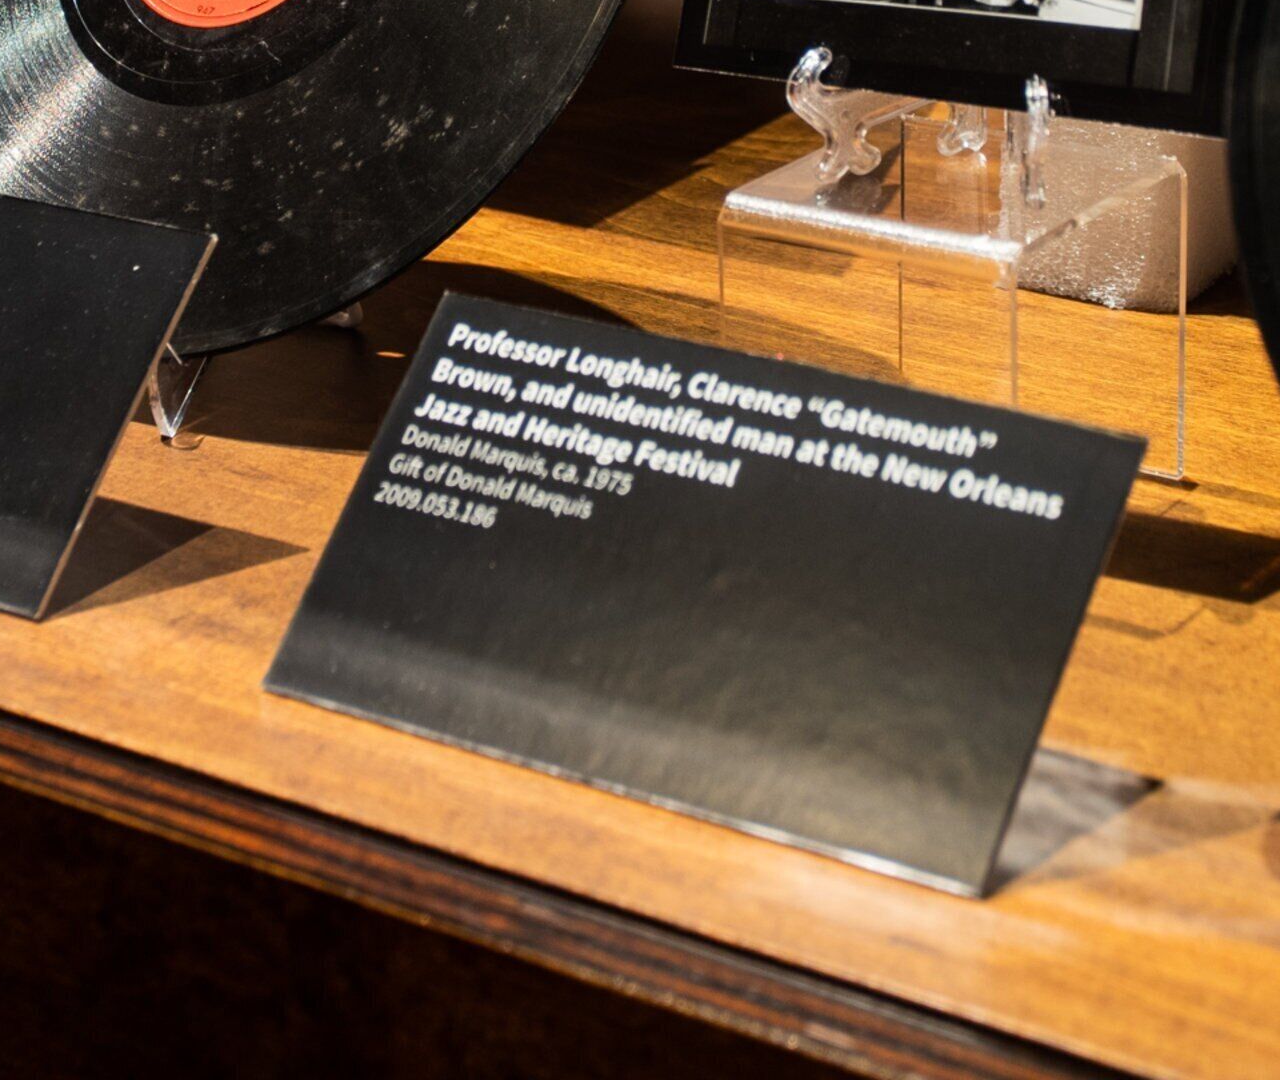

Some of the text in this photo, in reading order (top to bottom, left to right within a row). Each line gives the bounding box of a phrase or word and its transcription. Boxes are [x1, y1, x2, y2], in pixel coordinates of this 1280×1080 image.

[448, 323, 996, 455] Professor Longhair, Clarence “Gatemouth”
[402, 424, 631, 493] Donald Marquis, ca. 1975
[416, 393, 741, 487] Jazz and Heritage Festival
[432, 357, 1062, 516] Brown, and unidentified man at the New Orleans
[374, 482, 497, 527] 2009.053.186
[391, 453, 592, 518] Gift of Donald Marquis
